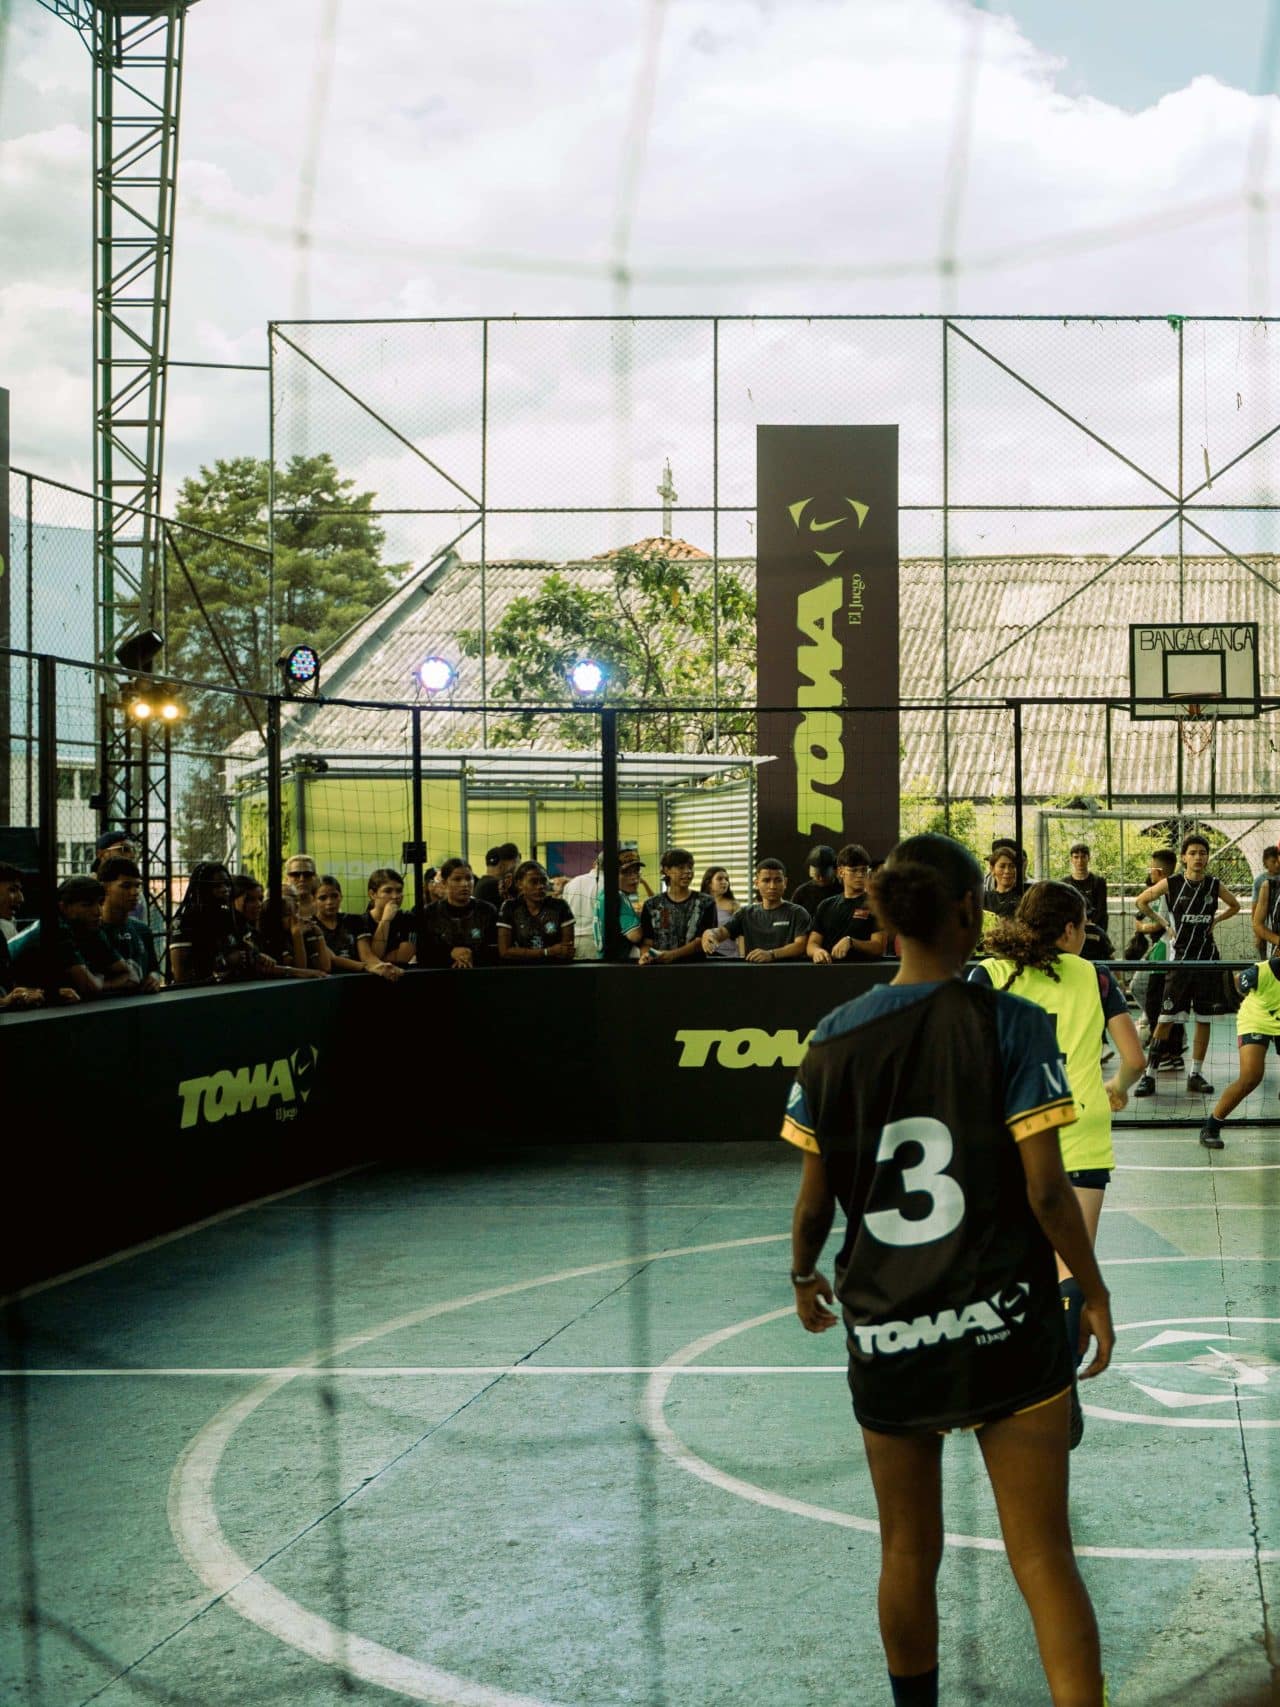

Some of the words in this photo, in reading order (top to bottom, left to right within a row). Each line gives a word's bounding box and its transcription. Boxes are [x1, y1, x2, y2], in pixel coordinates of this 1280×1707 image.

[849, 573, 865, 611] Juego
[848, 612, 861, 624] El
[1140, 630, 1196, 651] BANGA
[794, 577, 845, 835] TOMA
[675, 1028, 816, 1069] TOM
[178, 1058, 296, 1129] TOMA
[863, 1116, 966, 1246] 3
[853, 1300, 1006, 1355] TOMA
